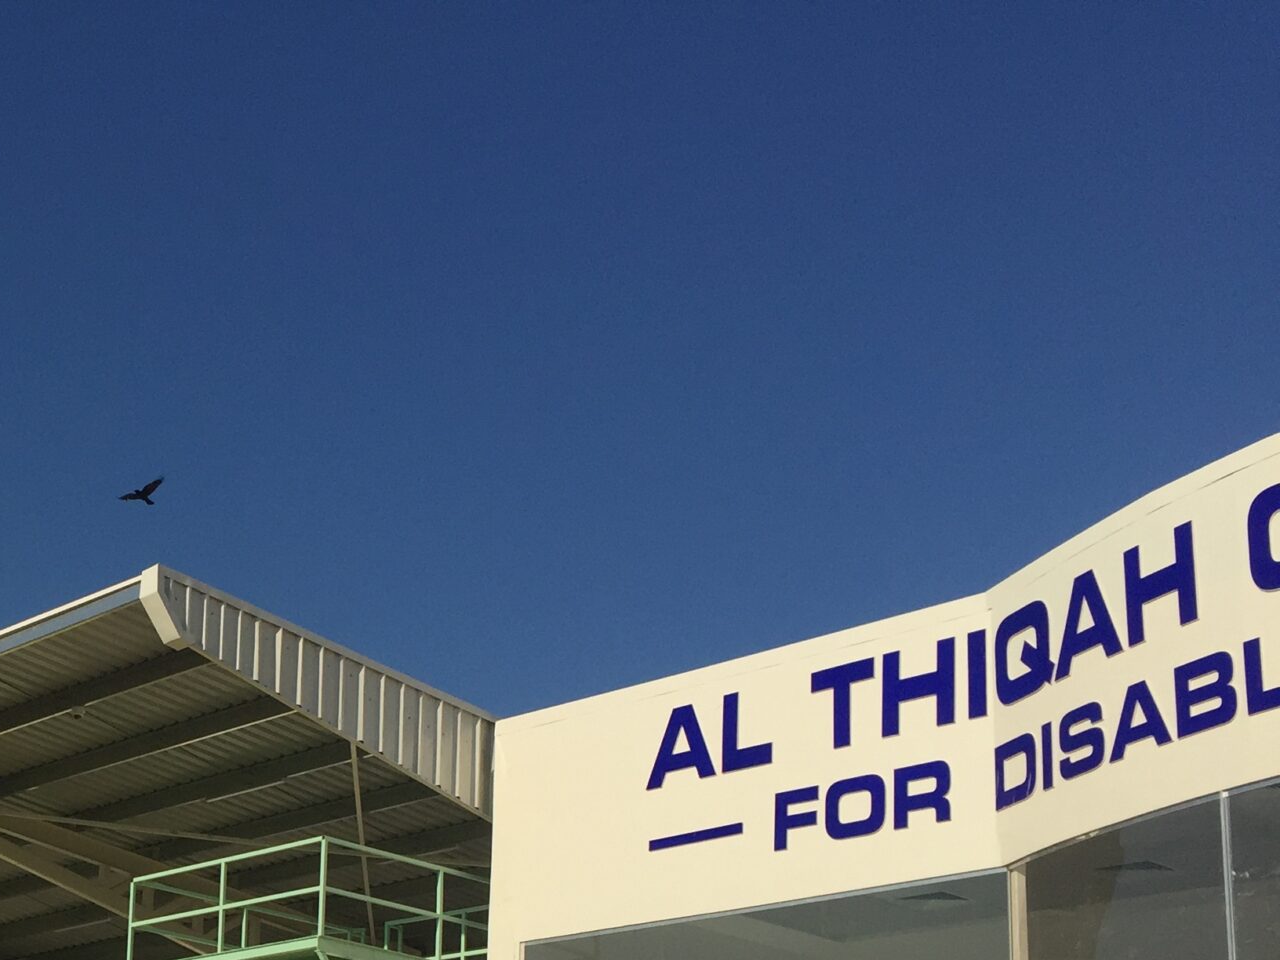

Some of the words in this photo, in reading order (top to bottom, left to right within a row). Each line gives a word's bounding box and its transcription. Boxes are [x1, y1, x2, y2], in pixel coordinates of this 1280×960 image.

[646, 692, 773, 790] AL
[811, 521, 1199, 749] THIQAH
[773, 760, 951, 850] FOR
